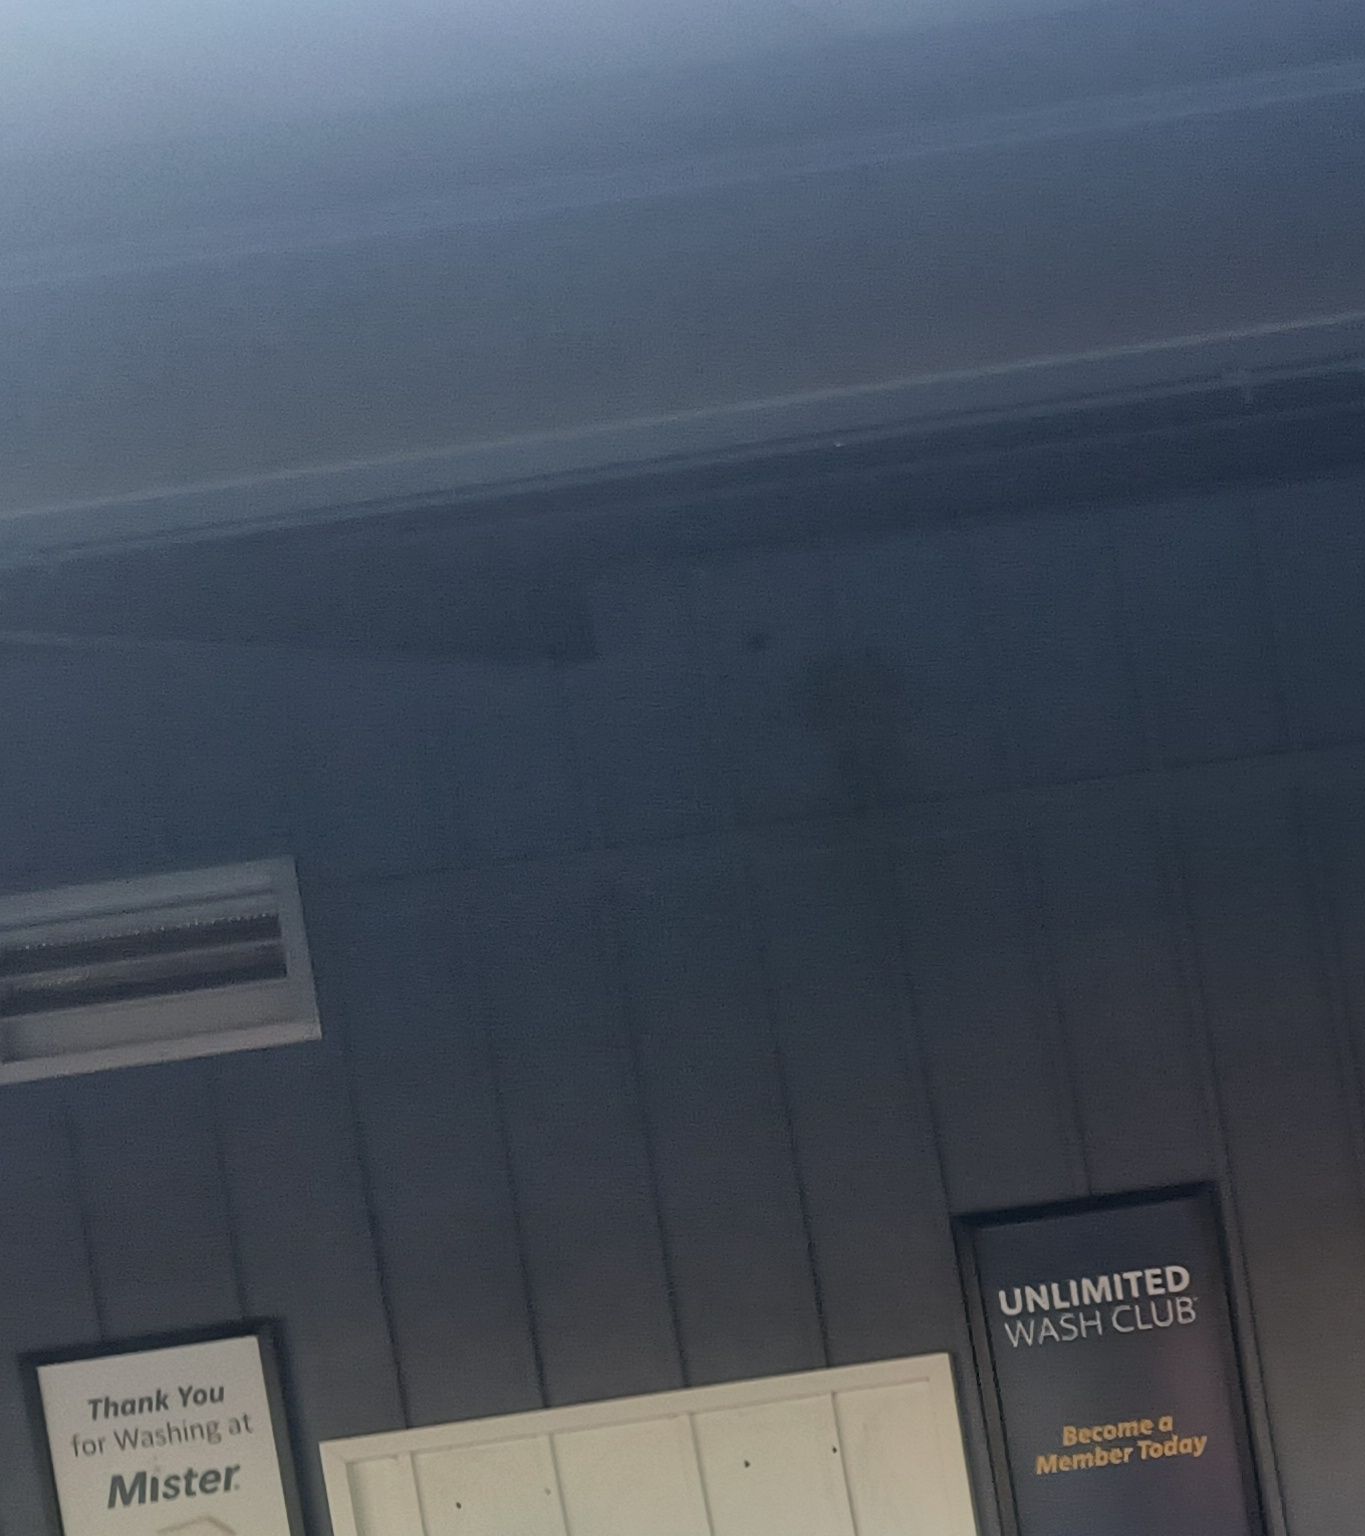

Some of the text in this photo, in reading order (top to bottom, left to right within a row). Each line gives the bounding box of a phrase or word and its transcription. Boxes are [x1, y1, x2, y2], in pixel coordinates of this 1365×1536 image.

[998, 1265, 1190, 1316] UNLIMITED
[1004, 1297, 1197, 1348] WASH CLUB
[88, 1385, 225, 1421] Thank You
[72, 1412, 253, 1457] for Washing at
[1062, 1415, 1173, 1447] Become a
[1036, 1433, 1208, 1475] Member Today
[107, 1464, 240, 1510] Mister
